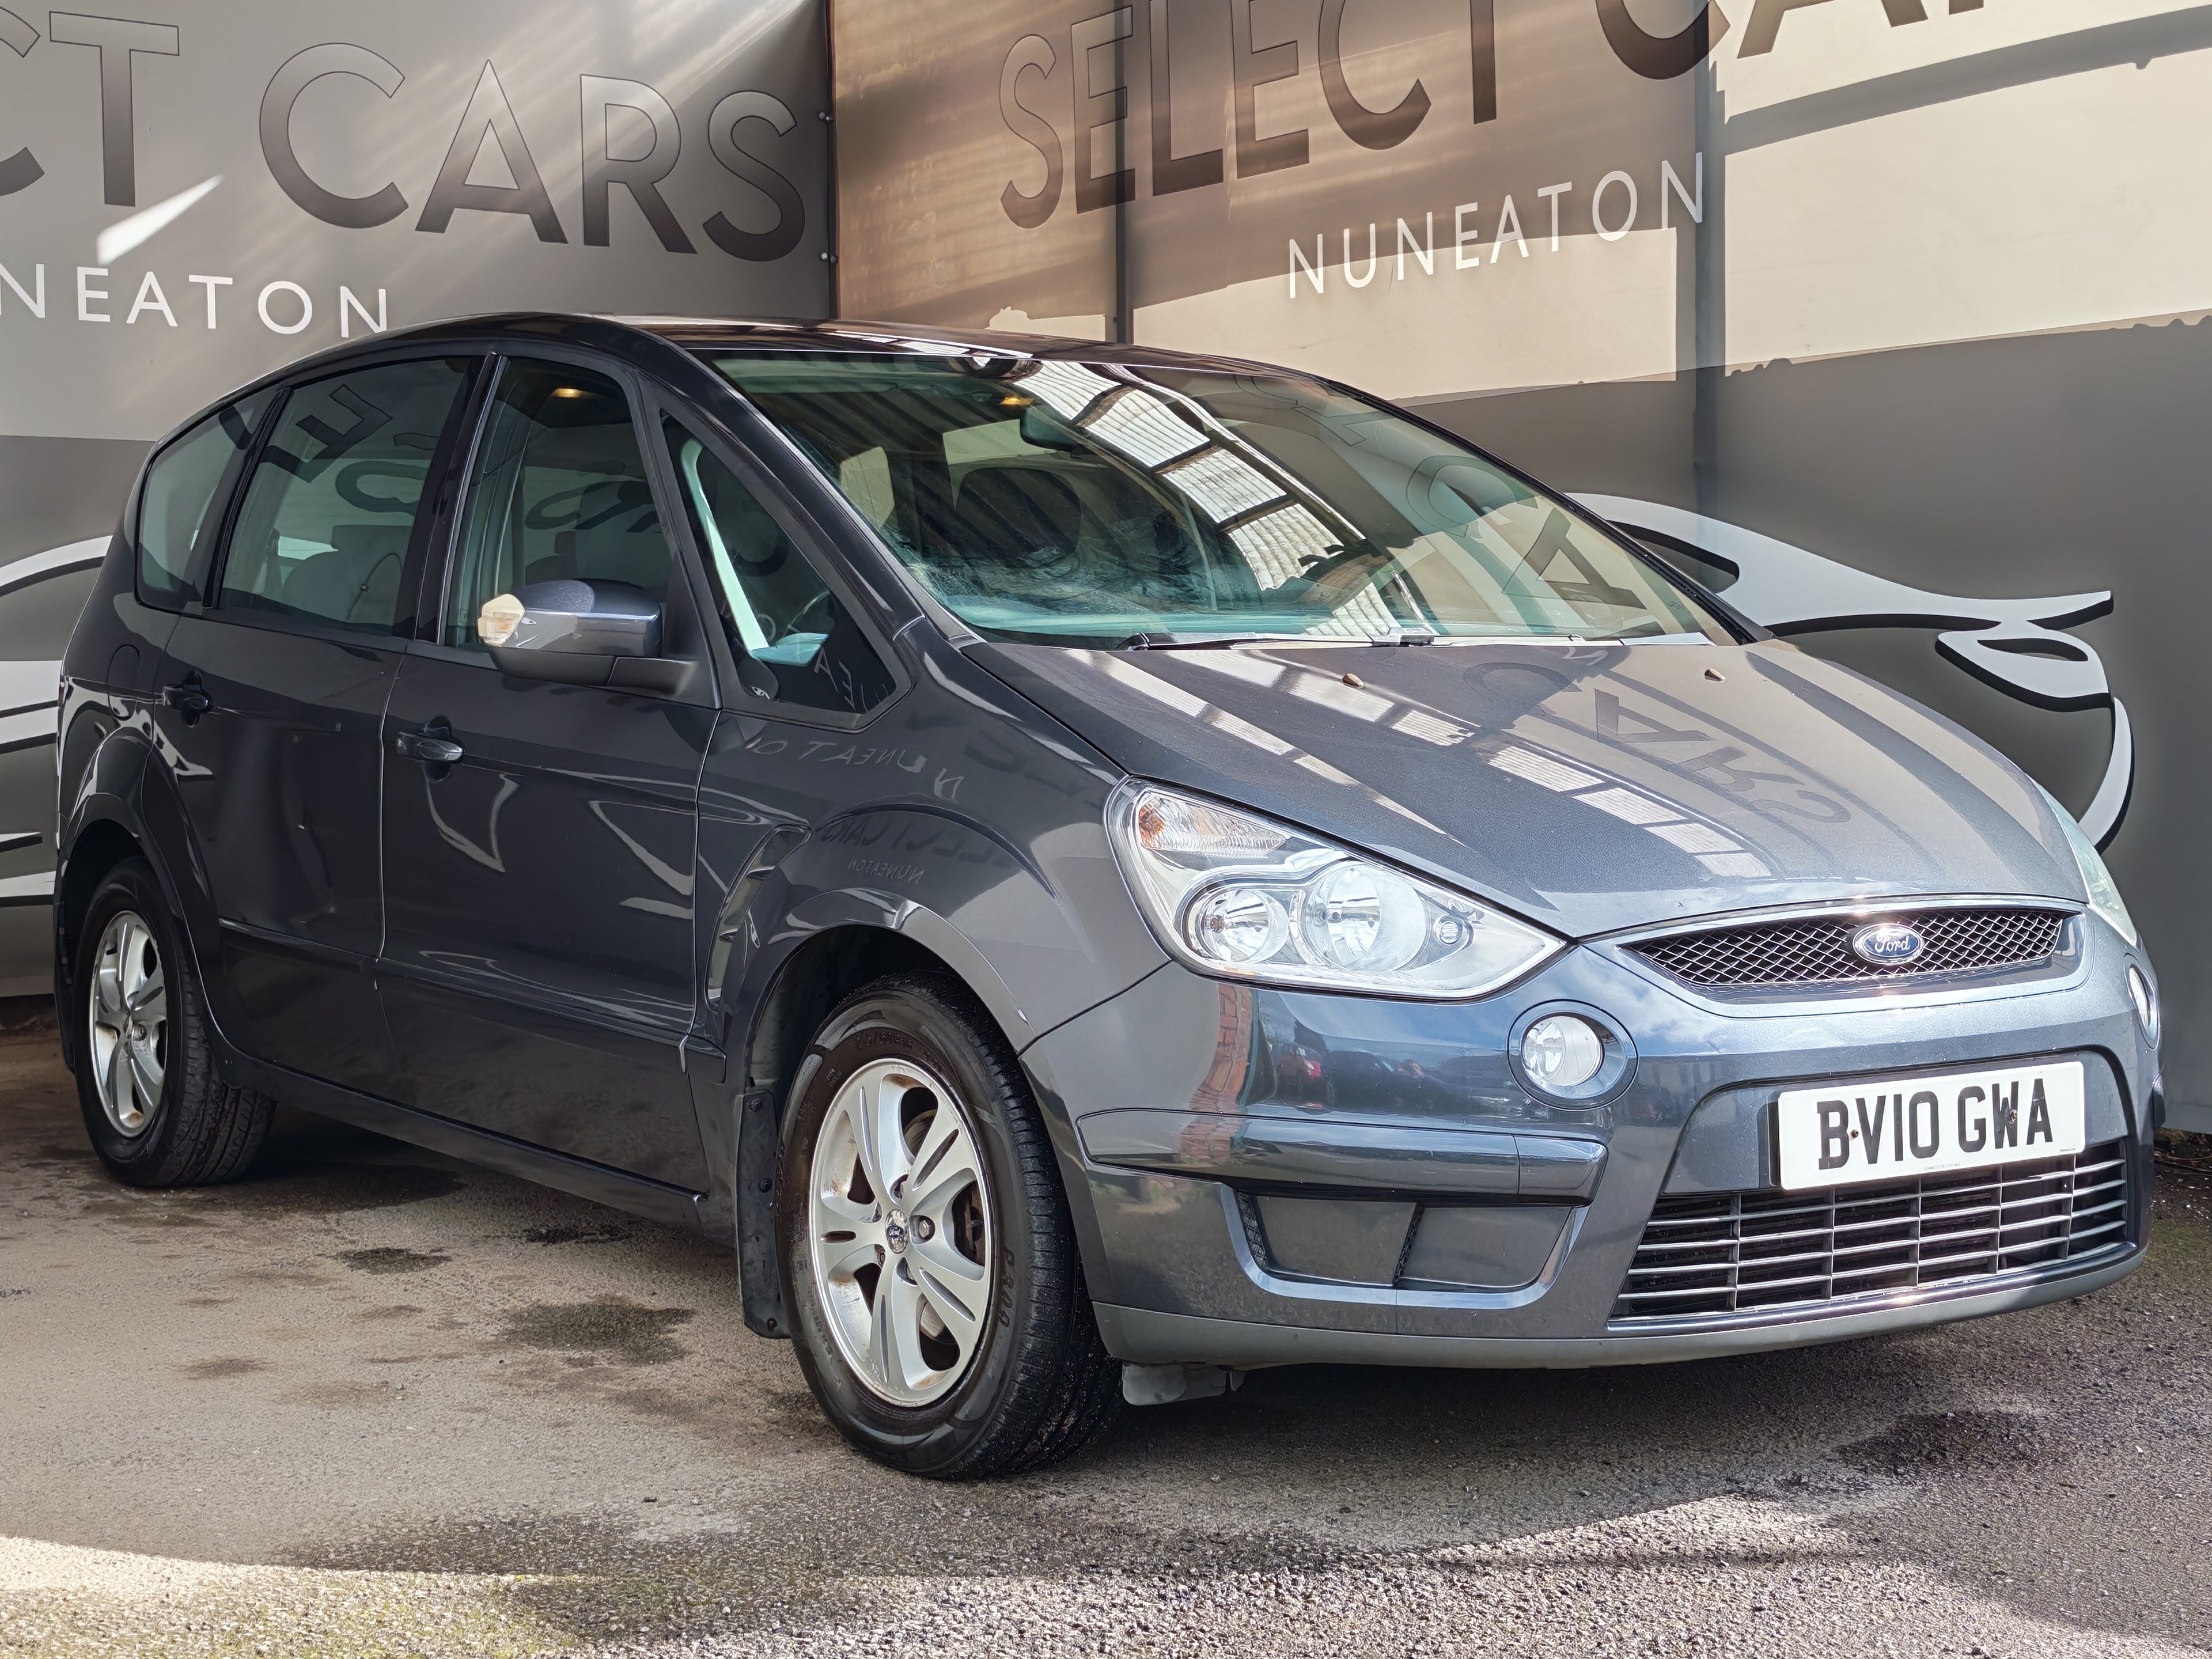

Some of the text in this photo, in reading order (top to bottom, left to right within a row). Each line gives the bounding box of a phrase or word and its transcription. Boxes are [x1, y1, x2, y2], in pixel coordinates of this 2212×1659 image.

[259, 42, 805, 262] CARS
[1288, 152, 1703, 300] NUNEATON
[1874, 930, 1911, 953] Ford
[1816, 1078, 2054, 1171] BV10 GWA
